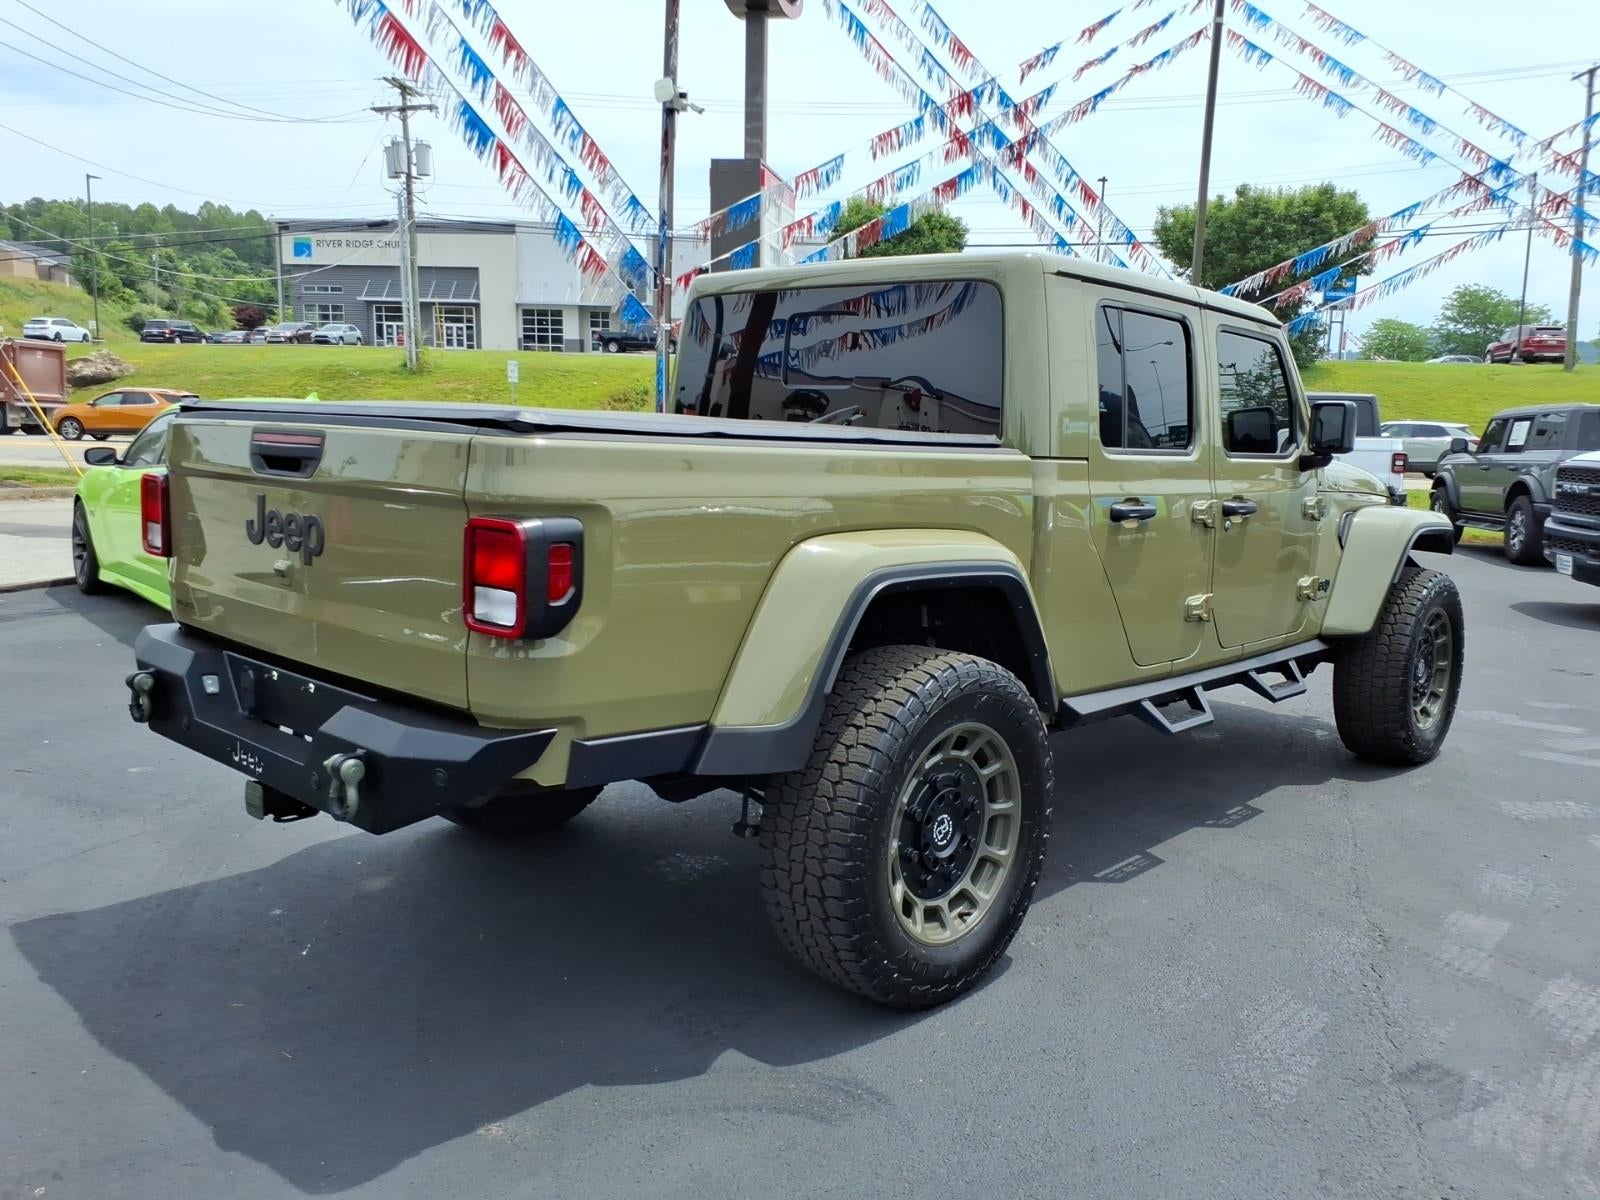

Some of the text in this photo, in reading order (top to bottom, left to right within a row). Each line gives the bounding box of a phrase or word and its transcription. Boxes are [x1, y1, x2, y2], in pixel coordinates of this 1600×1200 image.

[316, 239, 343, 249] RIVER
[345, 239, 375, 249] RIDGE
[246, 493, 326, 567] Jeep
[232, 740, 265, 776] Jeep
